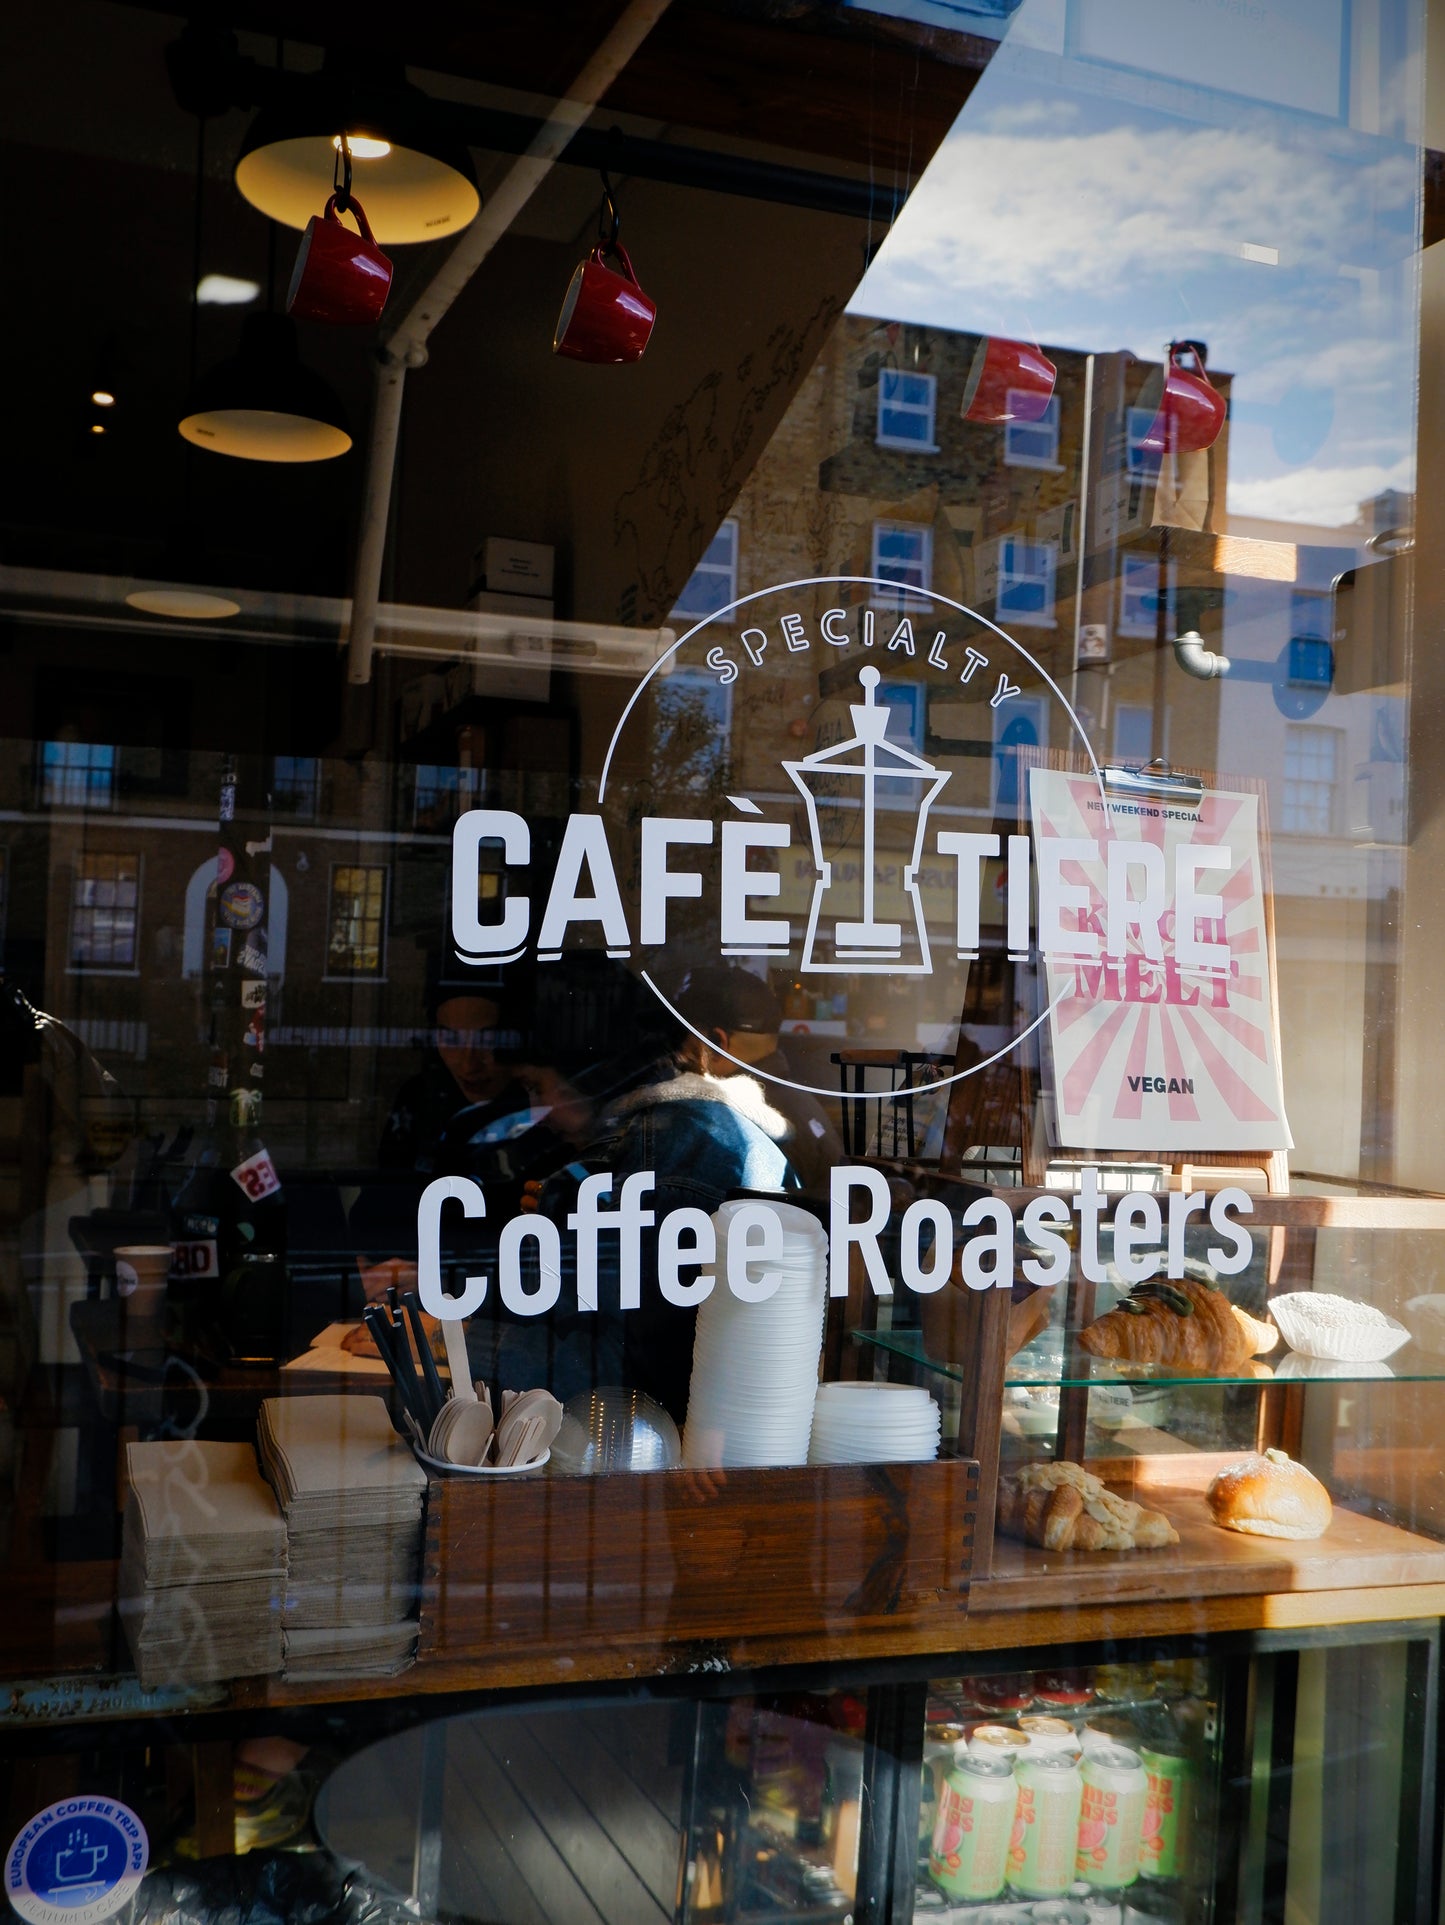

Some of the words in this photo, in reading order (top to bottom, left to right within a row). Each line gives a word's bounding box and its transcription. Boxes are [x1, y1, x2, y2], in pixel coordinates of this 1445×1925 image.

[706, 608, 1022, 710] SPECIALTY
[1087, 801, 1111, 813] NEW
[1111, 803, 1160, 818] WEEKEND
[1161, 810, 1205, 823] SPECIAL
[937, 831, 1233, 968] TIERE
[1076, 902, 1230, 946] KCHI
[1127, 1076, 1195, 1095] VEGAN
[417, 1170, 787, 1322] Coffee
[830, 1164, 1253, 1299] Roasters
[10, 1812, 54, 1888] EUROPEAN
[56, 1800, 114, 1817] COFFEE
[115, 1810, 139, 1839] TRIP
[131, 1842, 143, 1871] APP
[22, 1898, 93, 1923] FEATURED
